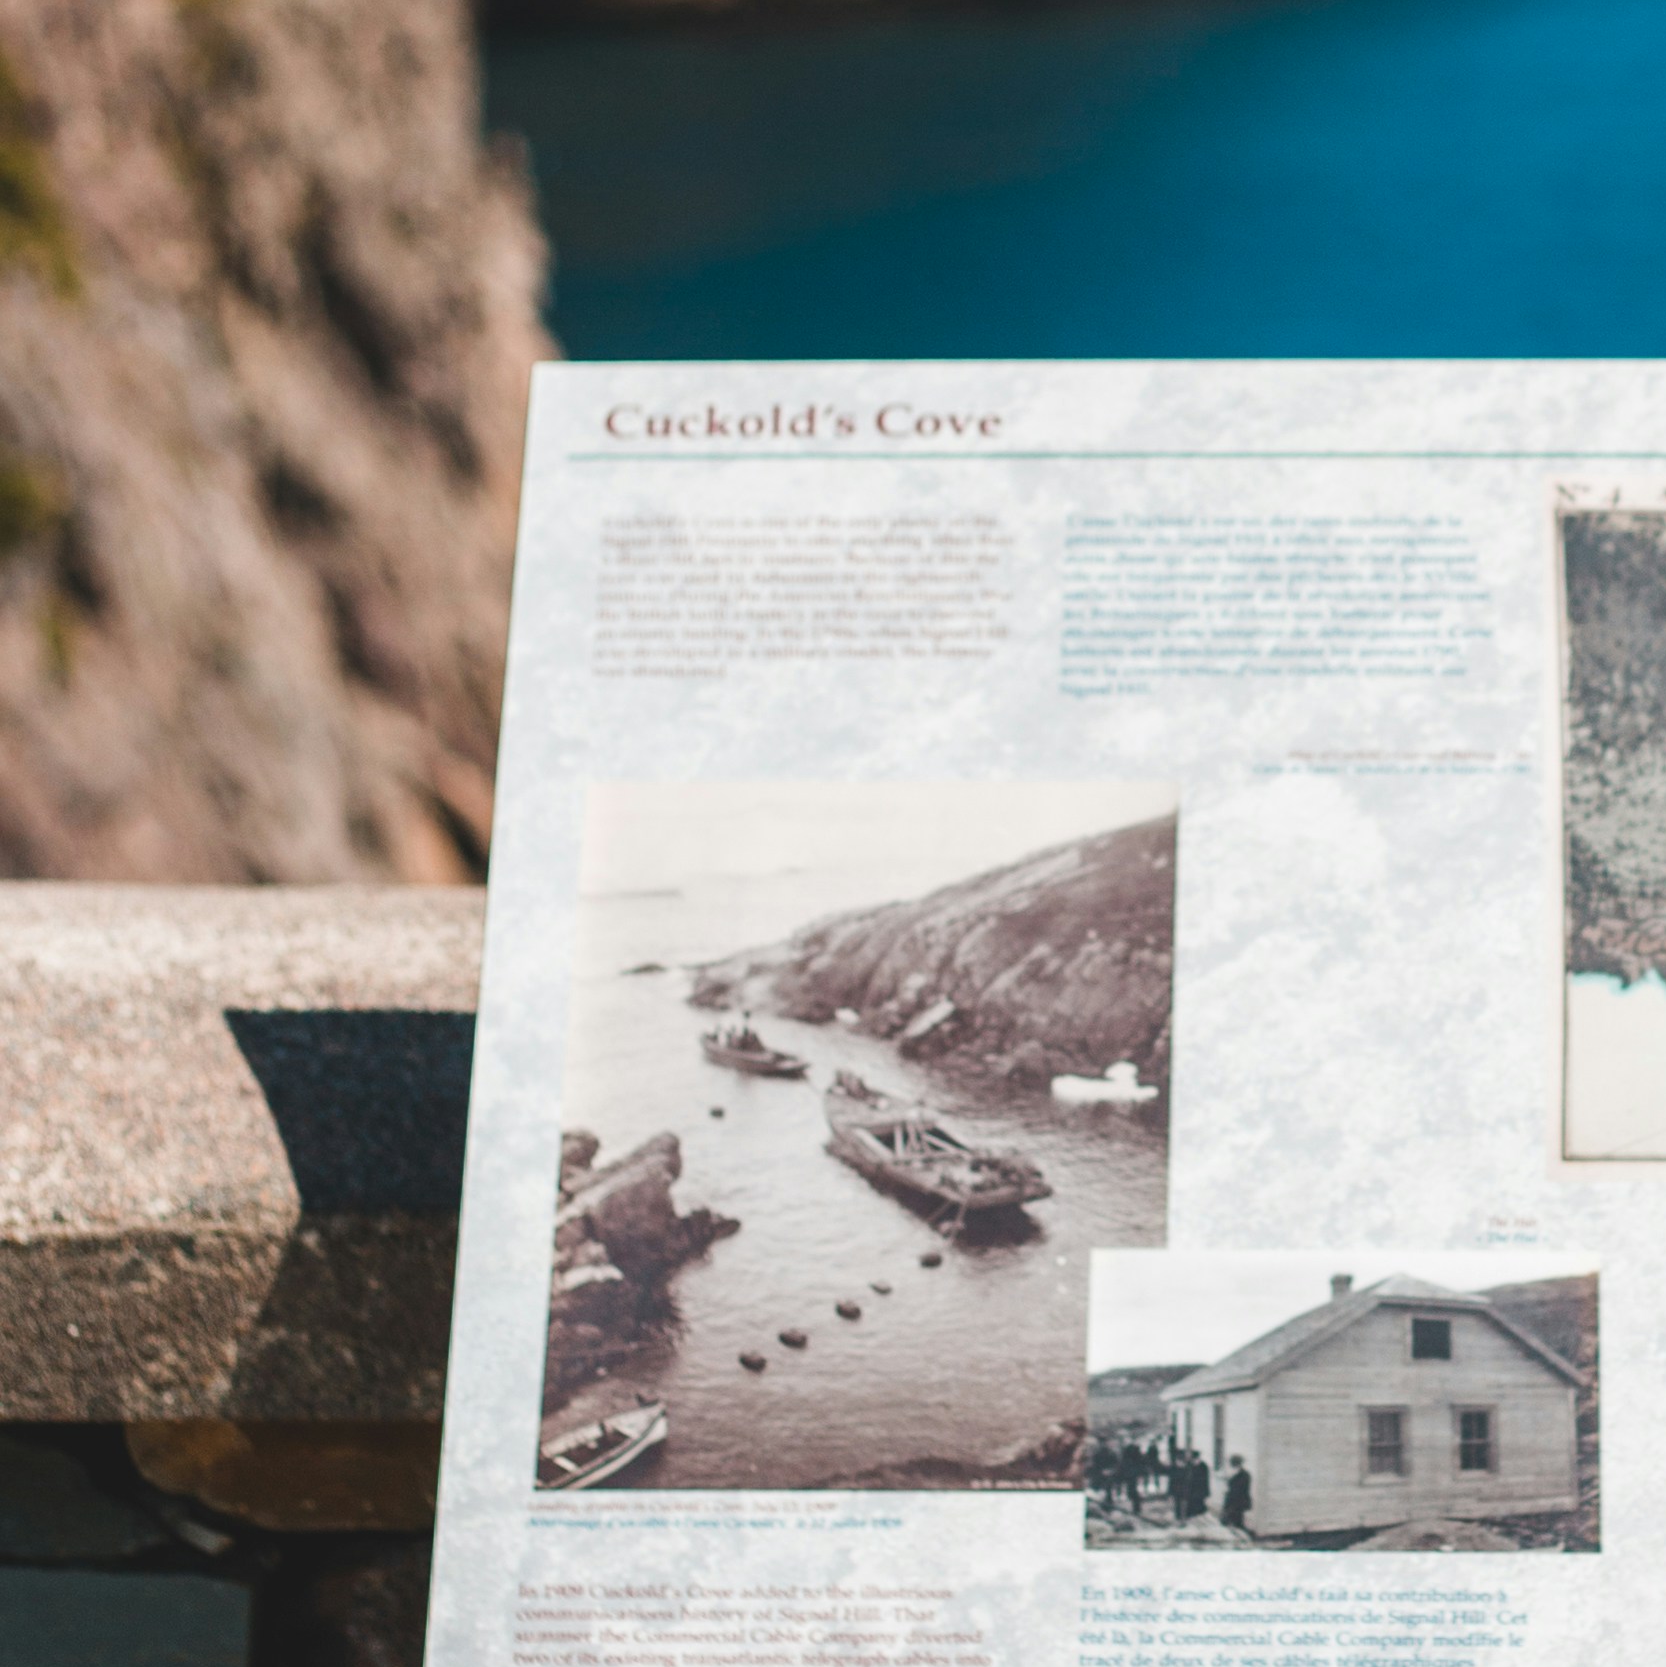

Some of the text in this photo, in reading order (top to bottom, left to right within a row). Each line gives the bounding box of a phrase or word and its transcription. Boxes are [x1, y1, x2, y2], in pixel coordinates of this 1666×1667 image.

[605, 404, 1002, 440] Cuckold's Cove
[1162, 1584, 1216, 1601] l'anse
[1220, 1585, 1314, 1601] Cuckold's
[1318, 1585, 1348, 1602] fait
[1377, 1585, 1492, 1602] contribution
[1079, 1606, 1162, 1623] l'histoire
[1202, 1607, 1356, 1624] communications
[1387, 1607, 1446, 1628] Signal
[1158, 1629, 1272, 1646] Commercial
[1276, 1630, 1330, 1647] Cable
[1334, 1630, 1426, 1650] Company
[1430, 1630, 1503, 1647] modifie
[1078, 1651, 1125, 1667] tracé
[1158, 1651, 1206, 1667] deux
[1272, 1651, 1331, 1667] câbles
